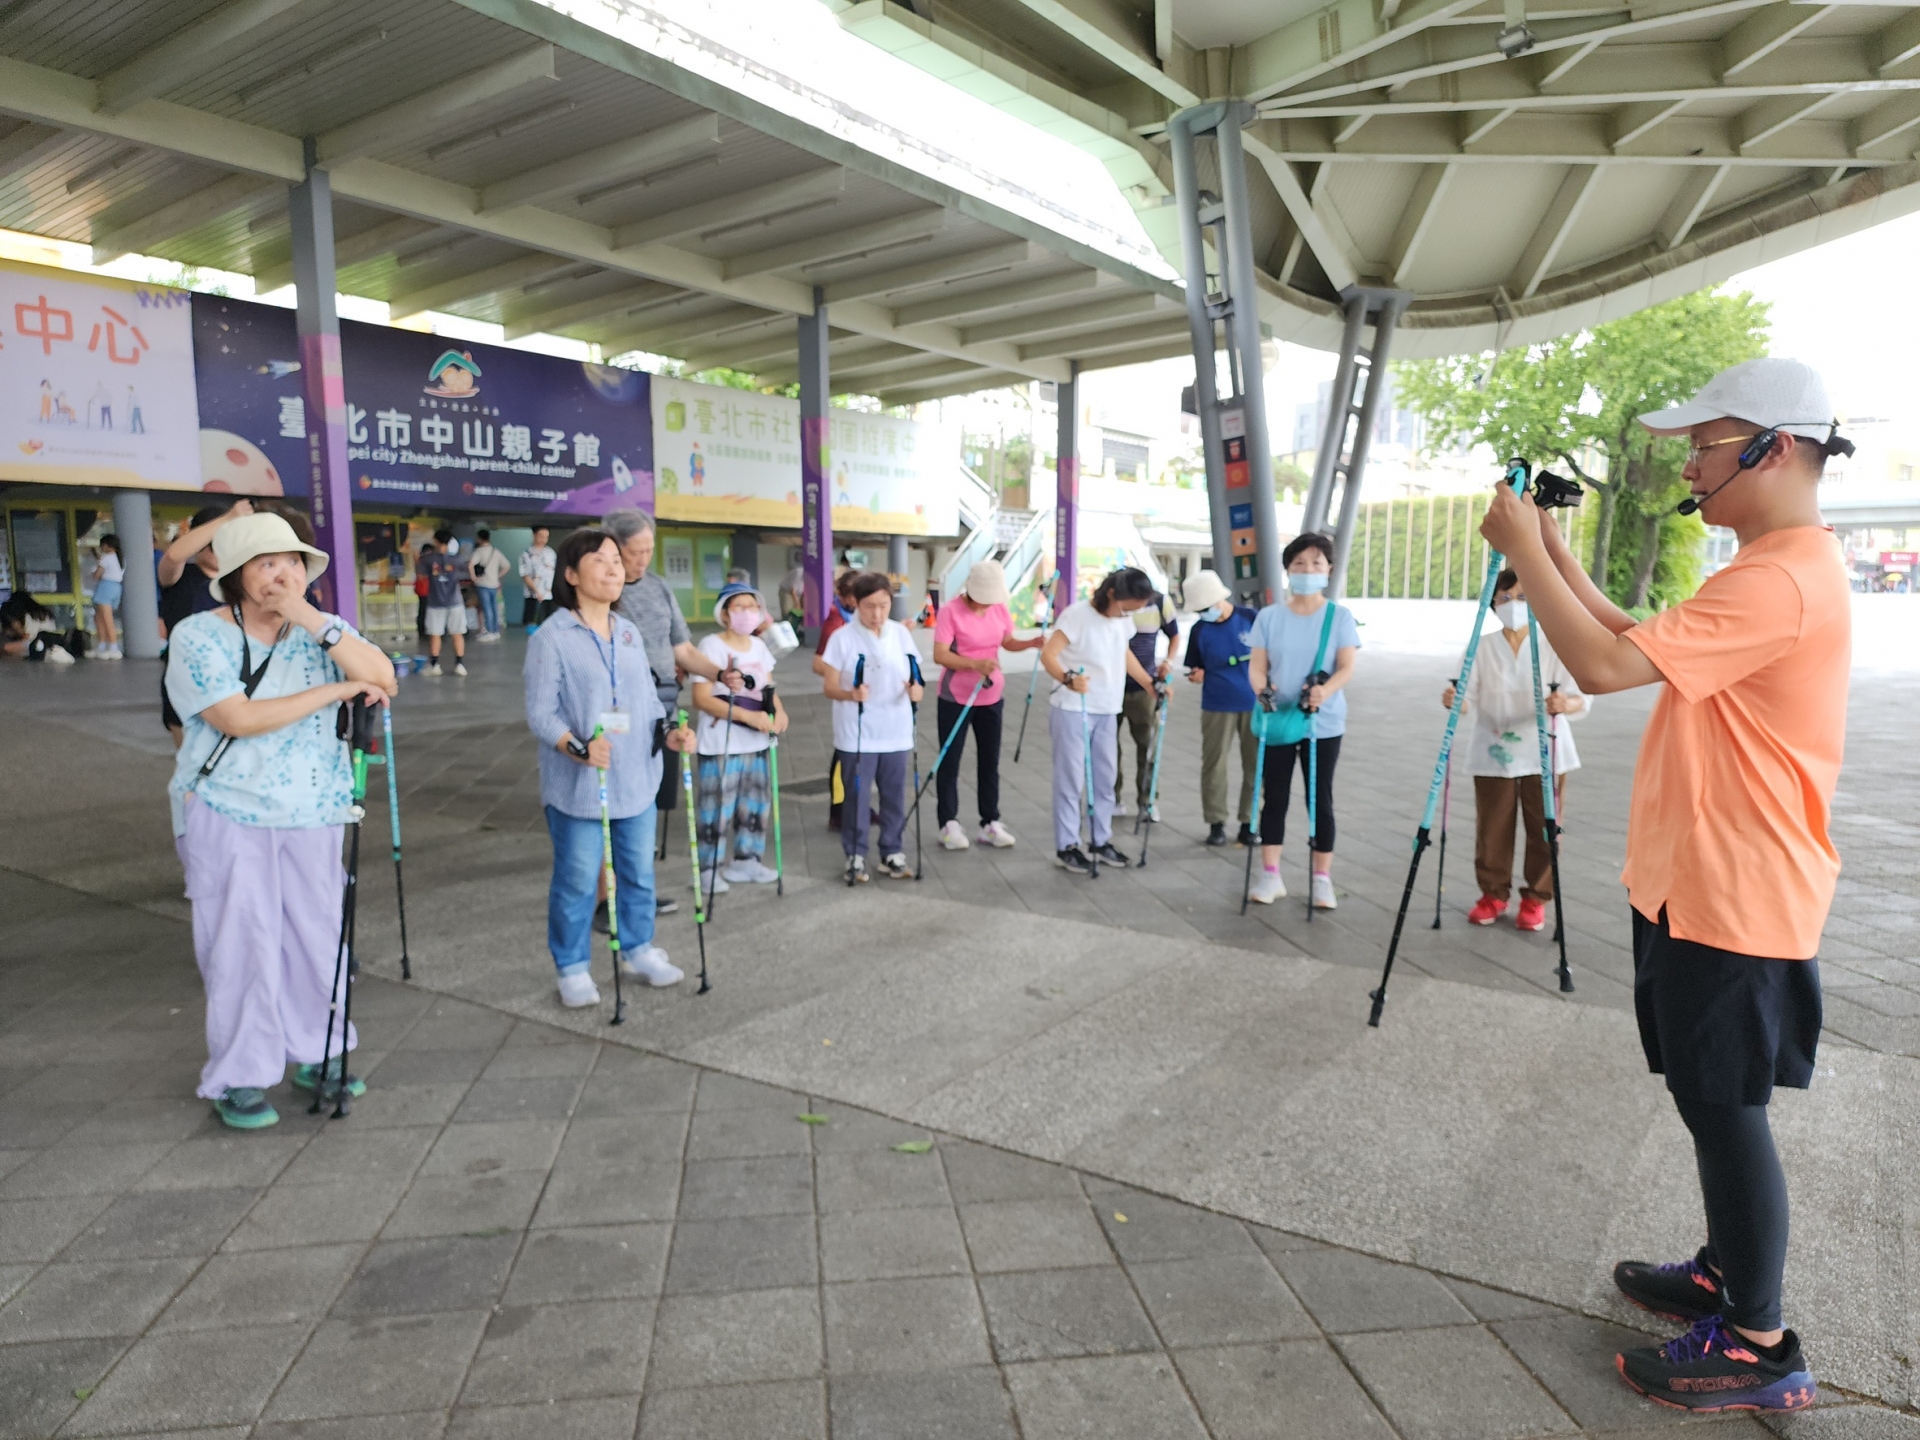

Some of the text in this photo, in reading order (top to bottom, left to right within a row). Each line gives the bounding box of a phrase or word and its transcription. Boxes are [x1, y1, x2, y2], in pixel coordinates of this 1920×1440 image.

[0, 295, 149, 365] 中心
[371, 446, 398, 466] city
[399, 448, 469, 470] Zhongshan
[469, 458, 540, 476] parent-child
[540, 464, 577, 479] center
[806, 482, 820, 560] Emower
[1668, 1373, 1762, 1393] STORM
